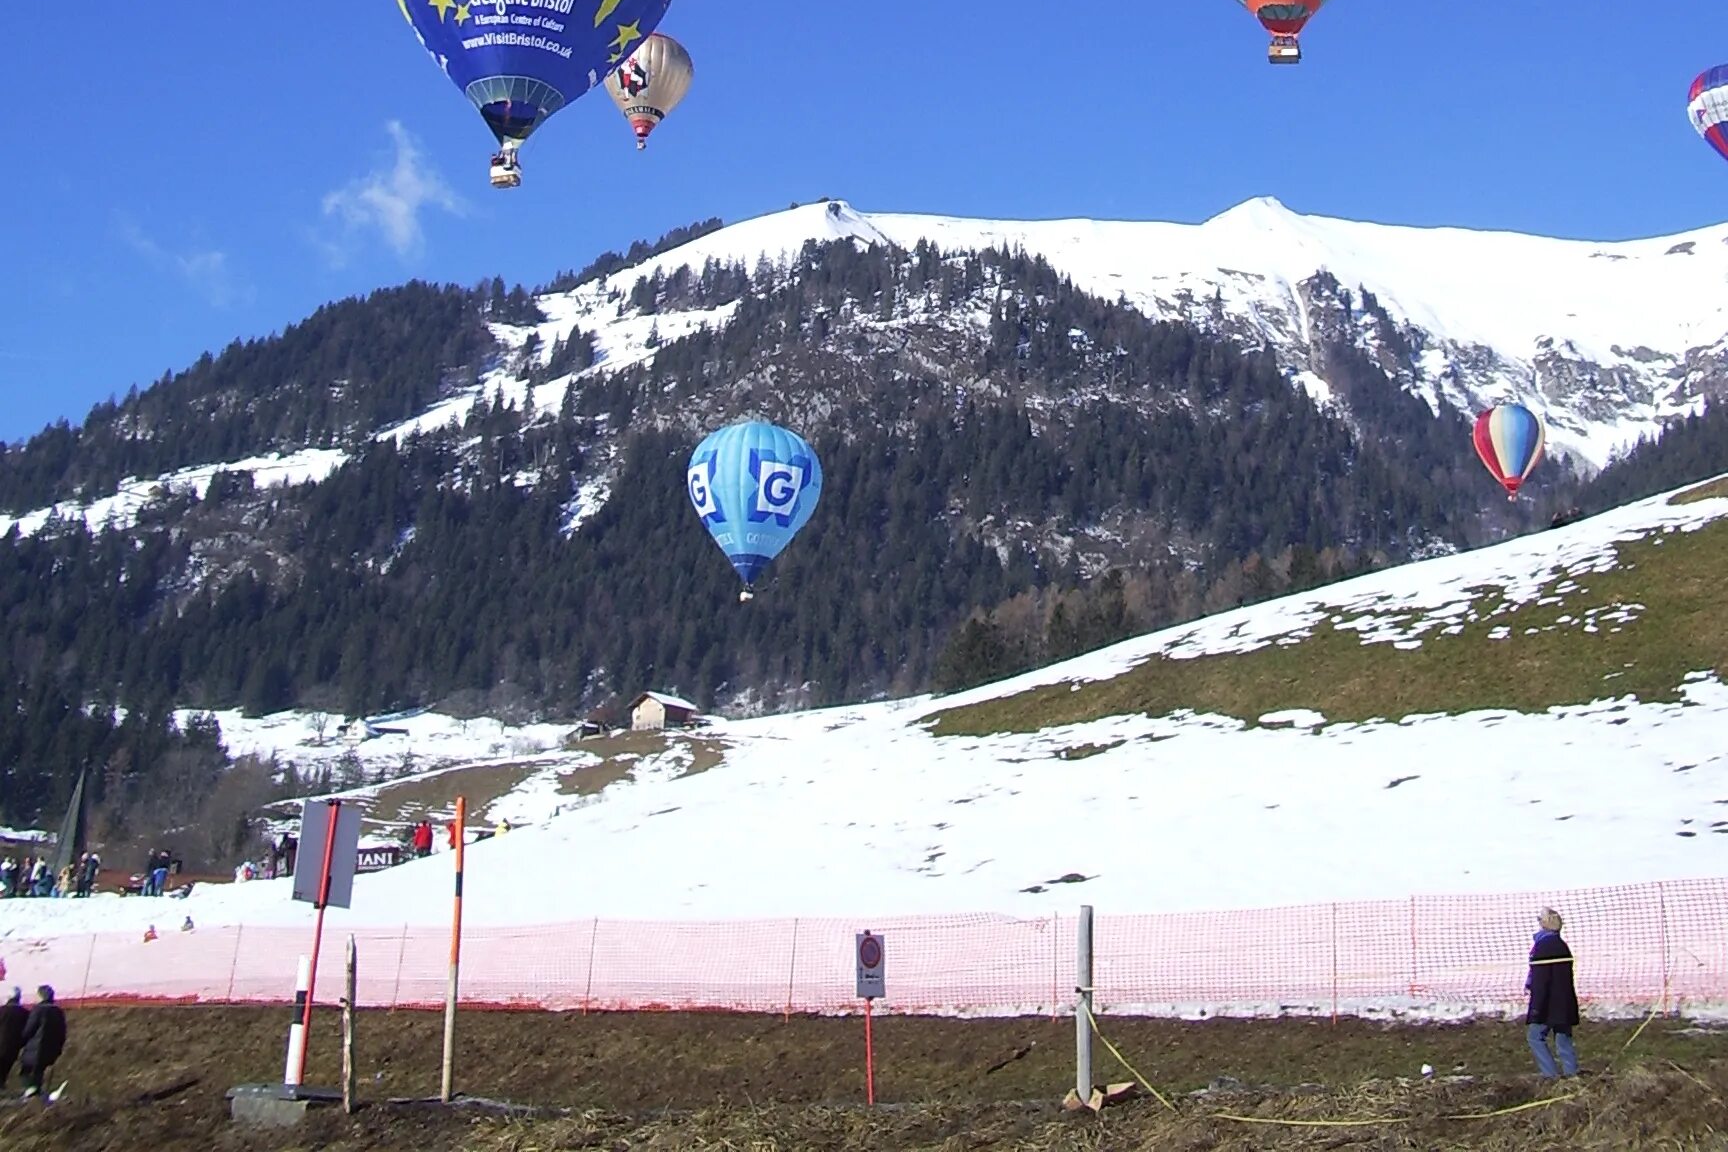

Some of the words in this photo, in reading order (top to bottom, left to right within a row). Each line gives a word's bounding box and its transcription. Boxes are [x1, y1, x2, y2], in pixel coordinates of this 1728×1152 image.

[480, 14, 509, 25] European
[511, 14, 532, 26] Centre
[533, 16, 541, 27] of
[542, 17, 564, 33] Culture
[462, 32, 573, 59] www.VisitBristol.co.uk
[764, 471, 795, 506] G
[358, 852, 393, 865] IANI
